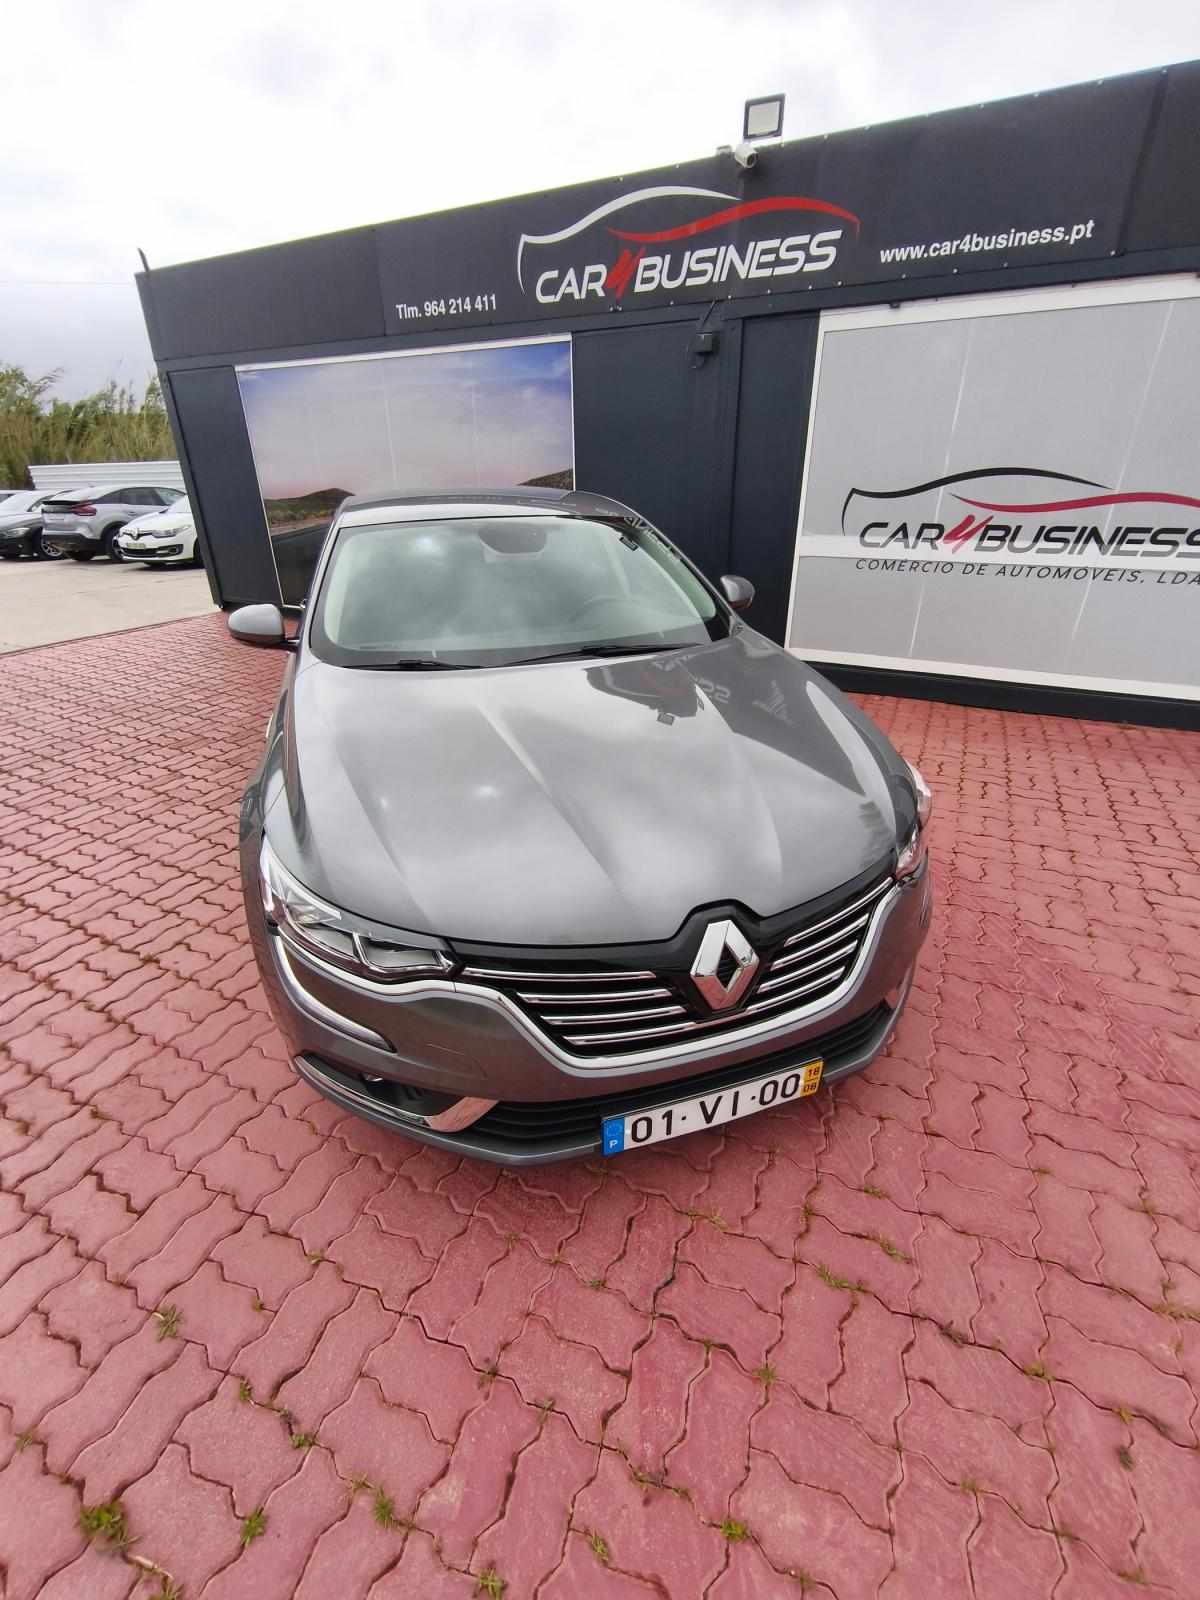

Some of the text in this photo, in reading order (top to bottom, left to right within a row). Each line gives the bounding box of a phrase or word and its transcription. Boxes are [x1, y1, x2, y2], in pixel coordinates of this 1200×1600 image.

[879, 219, 1095, 264] www.car4business.pt
[395, 293, 496, 320] Tlm. 964 214 411
[962, 563, 988, 576] DE
[608, 1139, 618, 1149] P
